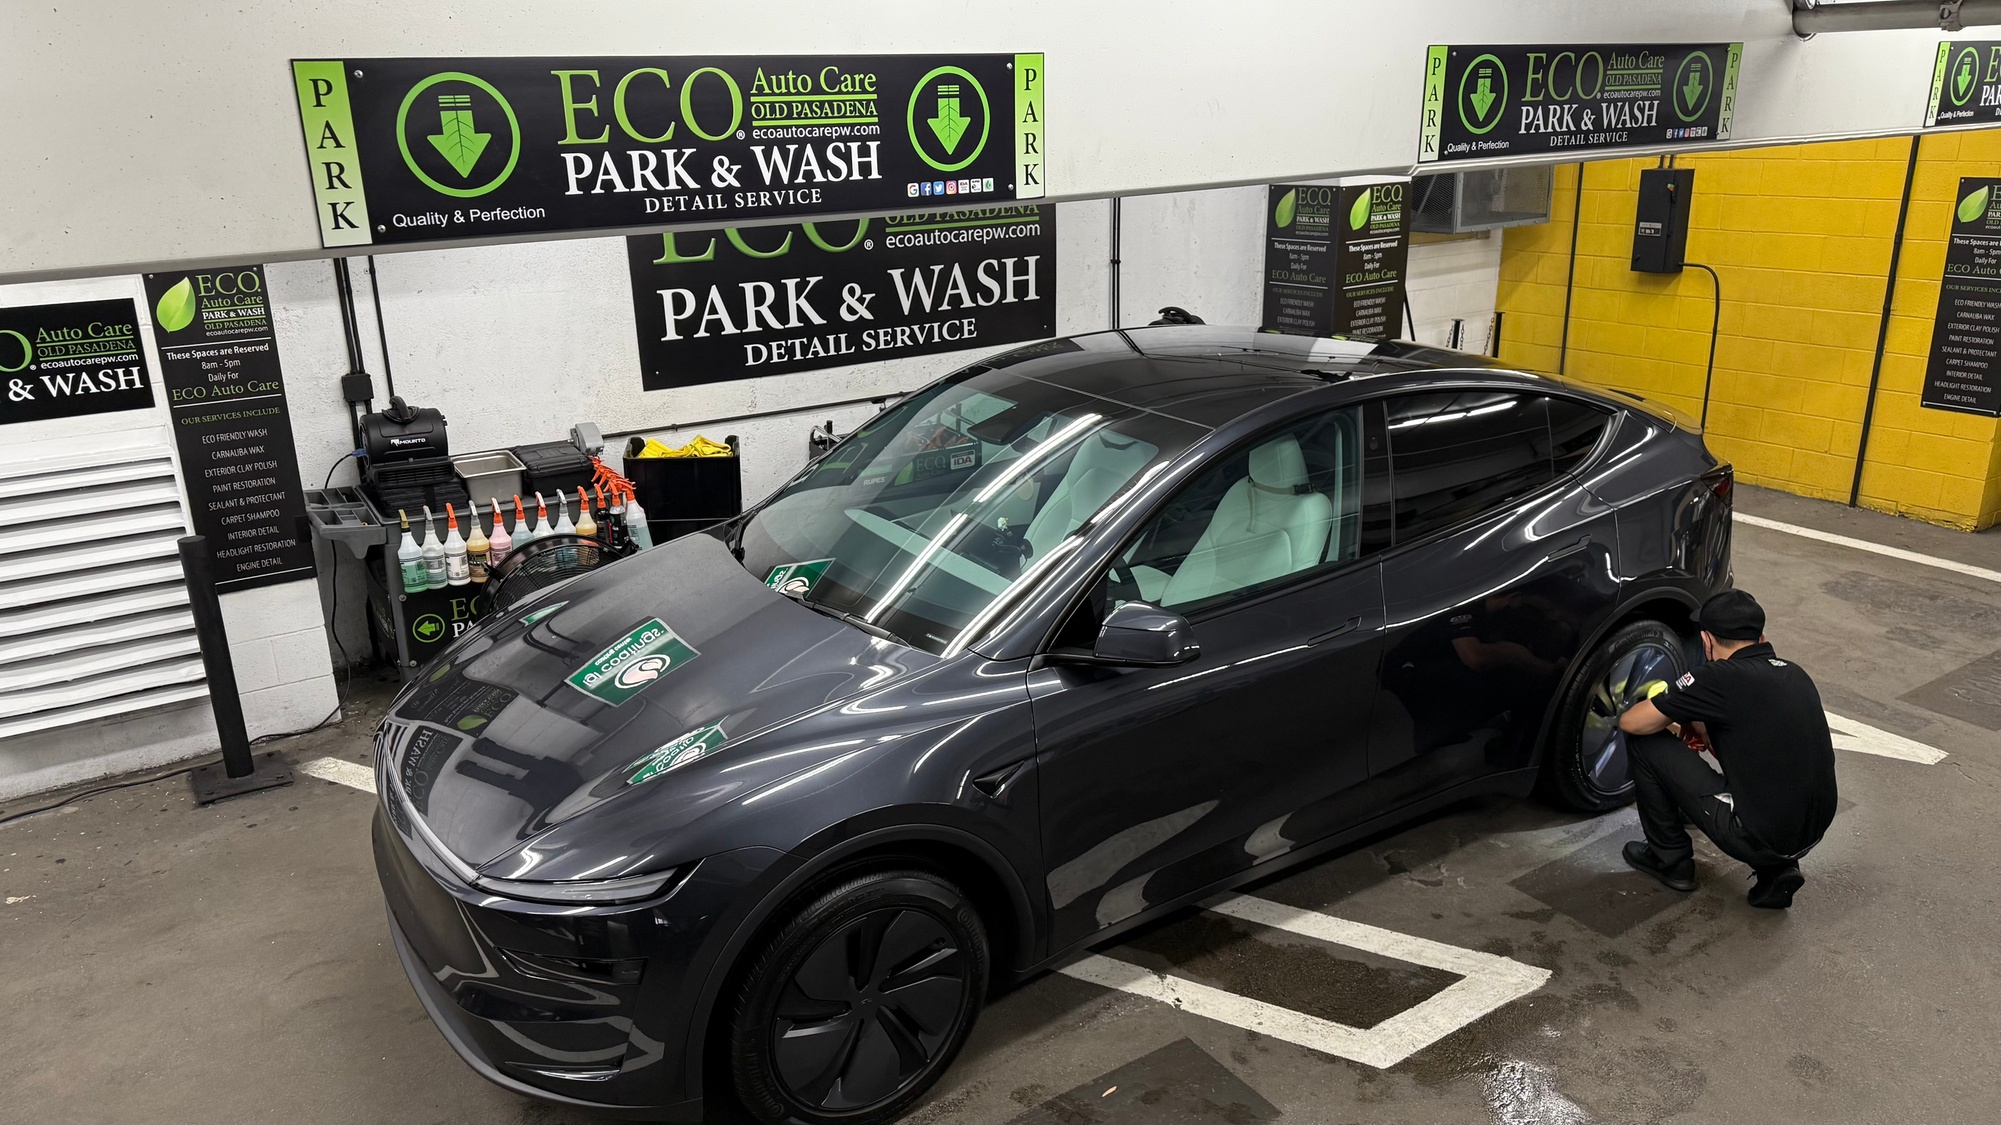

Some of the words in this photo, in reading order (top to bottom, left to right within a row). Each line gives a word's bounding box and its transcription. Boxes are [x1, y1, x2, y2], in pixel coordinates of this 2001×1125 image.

[1607, 52, 1636, 69] Auto
[1638, 50, 1665, 69] Care
[750, 67, 812, 93] Auto
[819, 65, 877, 93] Care
[1606, 75, 1622, 86] OLD
[1623, 74, 1662, 85] PASADENA
[1603, 90, 1661, 99] ecoautocarepw.com
[1721, 52, 1739, 133] PARK
[751, 103, 788, 119] OLD
[792, 101, 878, 118] PASADENA
[1424, 57, 1441, 153] PARK
[1518, 104, 1579, 134] PARK
[1581, 108, 1596, 131] &
[1601, 100, 1660, 129] WASH
[752, 125, 881, 139] ecoautocarepw.com
[1023, 68, 1039, 186] PARK
[1447, 142, 1470, 153] Quality
[1471, 141, 1477, 150] &
[1478, 140, 1509, 150] Perfection
[1549, 133, 1586, 147] DETAIL
[1588, 131, 1628, 144] SERVICE
[308, 77, 359, 230] PARK
[560, 148, 701, 195] PARK
[711, 155, 742, 188] &
[749, 140, 882, 186] WASH
[644, 194, 727, 213] DETAIL
[734, 188, 822, 208] SERVICE
[392, 211, 449, 229] Quality
[453, 209, 465, 224] &
[470, 205, 545, 222] Perfection
[885, 223, 1041, 248] ecoautocarepw.com
[1970, 238, 1989, 247] Spaces
[1947, 263, 1971, 273] ECO
[1973, 265, 1996, 275] Auto
[1974, 257, 1988, 265] Daily
[1345, 272, 1362, 284] ECO
[1363, 272, 1380, 281] Auto
[1381, 269, 1397, 278] Care
[1960, 285, 1988, 293] SERVICES
[201, 297, 231, 308] Auto
[234, 294, 263, 306] Care
[656, 275, 827, 342] PARK
[839, 282, 876, 322] &
[887, 255, 1041, 316] WASH
[1964, 300, 1987, 308] FRIENDLY
[202, 310, 228, 320] PARK
[229, 310, 237, 318] &
[238, 307, 265, 317] WASH
[1956, 312, 1983, 320] CARNAUBA
[1983, 313, 1995, 321] WAX
[35, 327, 82, 343] Auto
[88, 322, 133, 338] Care
[204, 323, 222, 331] OLD
[224, 319, 267, 329] PASADENA
[206, 326, 268, 337] ecoautocarepw.com
[1947, 322, 1970, 331] EXTERIOR
[1970, 324, 1982, 332] CLAY
[1982, 325, 2000, 333] POLISH
[744, 333, 855, 366] DETAIL
[862, 317, 977, 350] SERVICE
[1949, 334, 1962, 342] PAINT
[1963, 336, 1995, 345] RESTORATION
[37, 346, 66, 357] OLD
[69, 340, 136, 354] PASADENA
[166, 351, 190, 361] These
[191, 349, 218, 359] Spaces
[234, 343, 269, 354] Reserved
[1941, 346, 1962, 354] SEALANT
[1967, 348, 1997, 358] PROTECTANT
[40, 353, 139, 370] ecoautocarepw.com
[201, 361, 218, 370] 8am
[224, 359, 241, 369] 5pm
[1946, 358, 1964, 367] CARPET
[1964, 360, 1989, 369] SHAMPOO
[208, 373, 226, 382] Daily
[227, 371, 239, 380] For
[1946, 370, 1968, 378] INTERIOR
[1968, 372, 1983, 381] DETAIL
[8, 378, 35, 402] &
[39, 366, 144, 398] WASH
[171, 386, 206, 401] ECO
[211, 384, 244, 397] Auto
[247, 380, 279, 392] Care
[1934, 381, 1960, 390] HEADLIGHT
[1960, 383, 1992, 393] RESTORATION
[1944, 393, 1961, 402] ENGINE
[1961, 395, 1977, 404] DETAIL
[181, 416, 201, 425] OUR
[201, 412, 242, 423] SERVICES
[242, 407, 280, 418] INCLUDE
[202, 435, 216, 444] ECO
[216, 430, 247, 442] FRIENDLY
[247, 428, 268, 438] WASH
[211, 448, 248, 460] CARNAUBA
[248, 445, 265, 455] WAX
[204, 466, 237, 478] EXTERIOR
[236, 463, 253, 473] CLAY
[254, 460, 278, 471] POLISH
[953, 456, 972, 466] IDA
[212, 484, 232, 493] PAINT
[233, 477, 276, 490] RESTORATION
[208, 499, 238, 511] SEALANT
[239, 498, 245, 506] &
[246, 492, 286, 504] PROTECTANT
[221, 514, 246, 526] CARPET
[246, 509, 280, 522] SHAMPOO
[227, 529, 257, 541] INTERIOR
[258, 525, 279, 536] DETAIL
[216, 545, 253, 559] HEADLIGHT
[254, 539, 296, 553] RESTORATION
[236, 560, 260, 572] ENGINE
[261, 557, 283, 568] DETAIL
